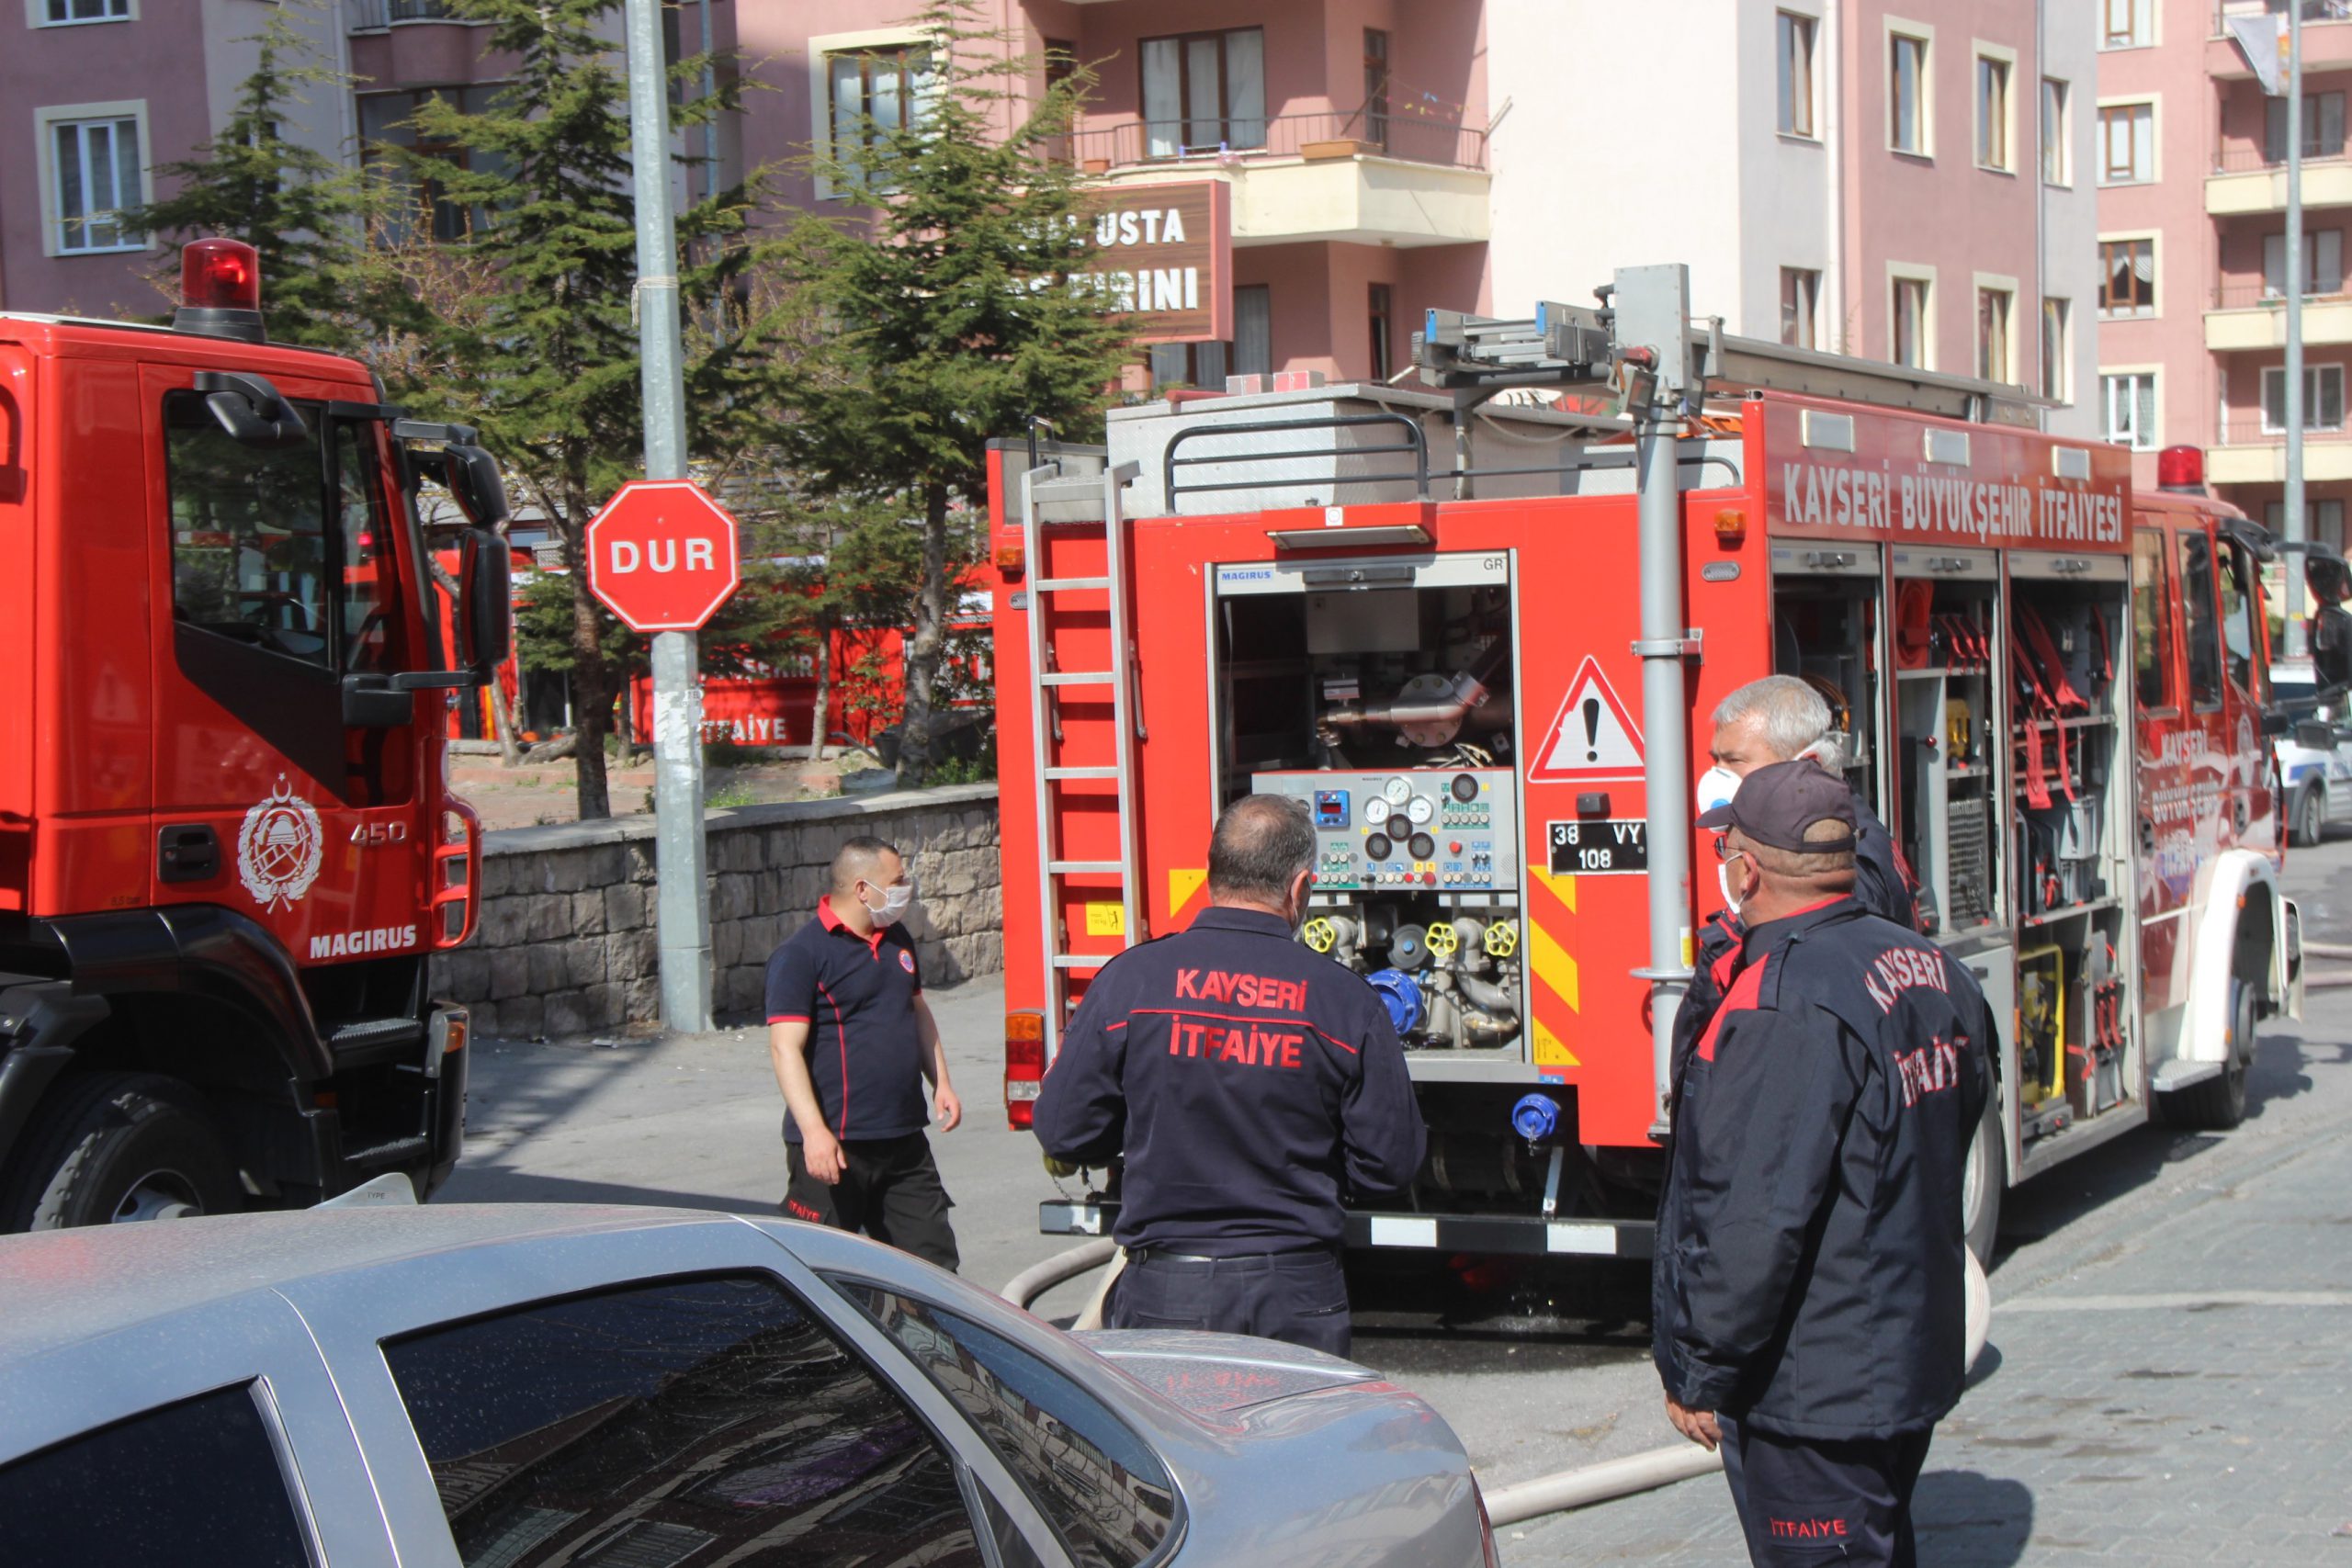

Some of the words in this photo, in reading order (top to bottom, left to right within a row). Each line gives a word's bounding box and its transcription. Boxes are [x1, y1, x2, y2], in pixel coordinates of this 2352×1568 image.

[1096, 208, 1186, 247] USTA
[1783, 458, 1891, 529] KAYSERİ
[1901, 463, 2032, 544] BÜYÜKŞEHİR
[2039, 477, 2122, 542] İTFAİYESİ
[610, 538, 714, 574] DUR
[1484, 558, 1504, 571] GR
[1221, 570, 1272, 581] MAGIRUS
[350, 820, 407, 846] 450
[1555, 825, 1579, 845] 38
[1613, 824, 1641, 845] VY
[1578, 848, 1611, 869] 108
[310, 924, 416, 959] MAGIRUS
[1175, 968, 1307, 1012] KAYSERİ
[1864, 947, 1950, 1015] KAYSERİ
[1170, 1014, 1304, 1068] İTFAİYE
[368, 1190, 386, 1200] TYPE
